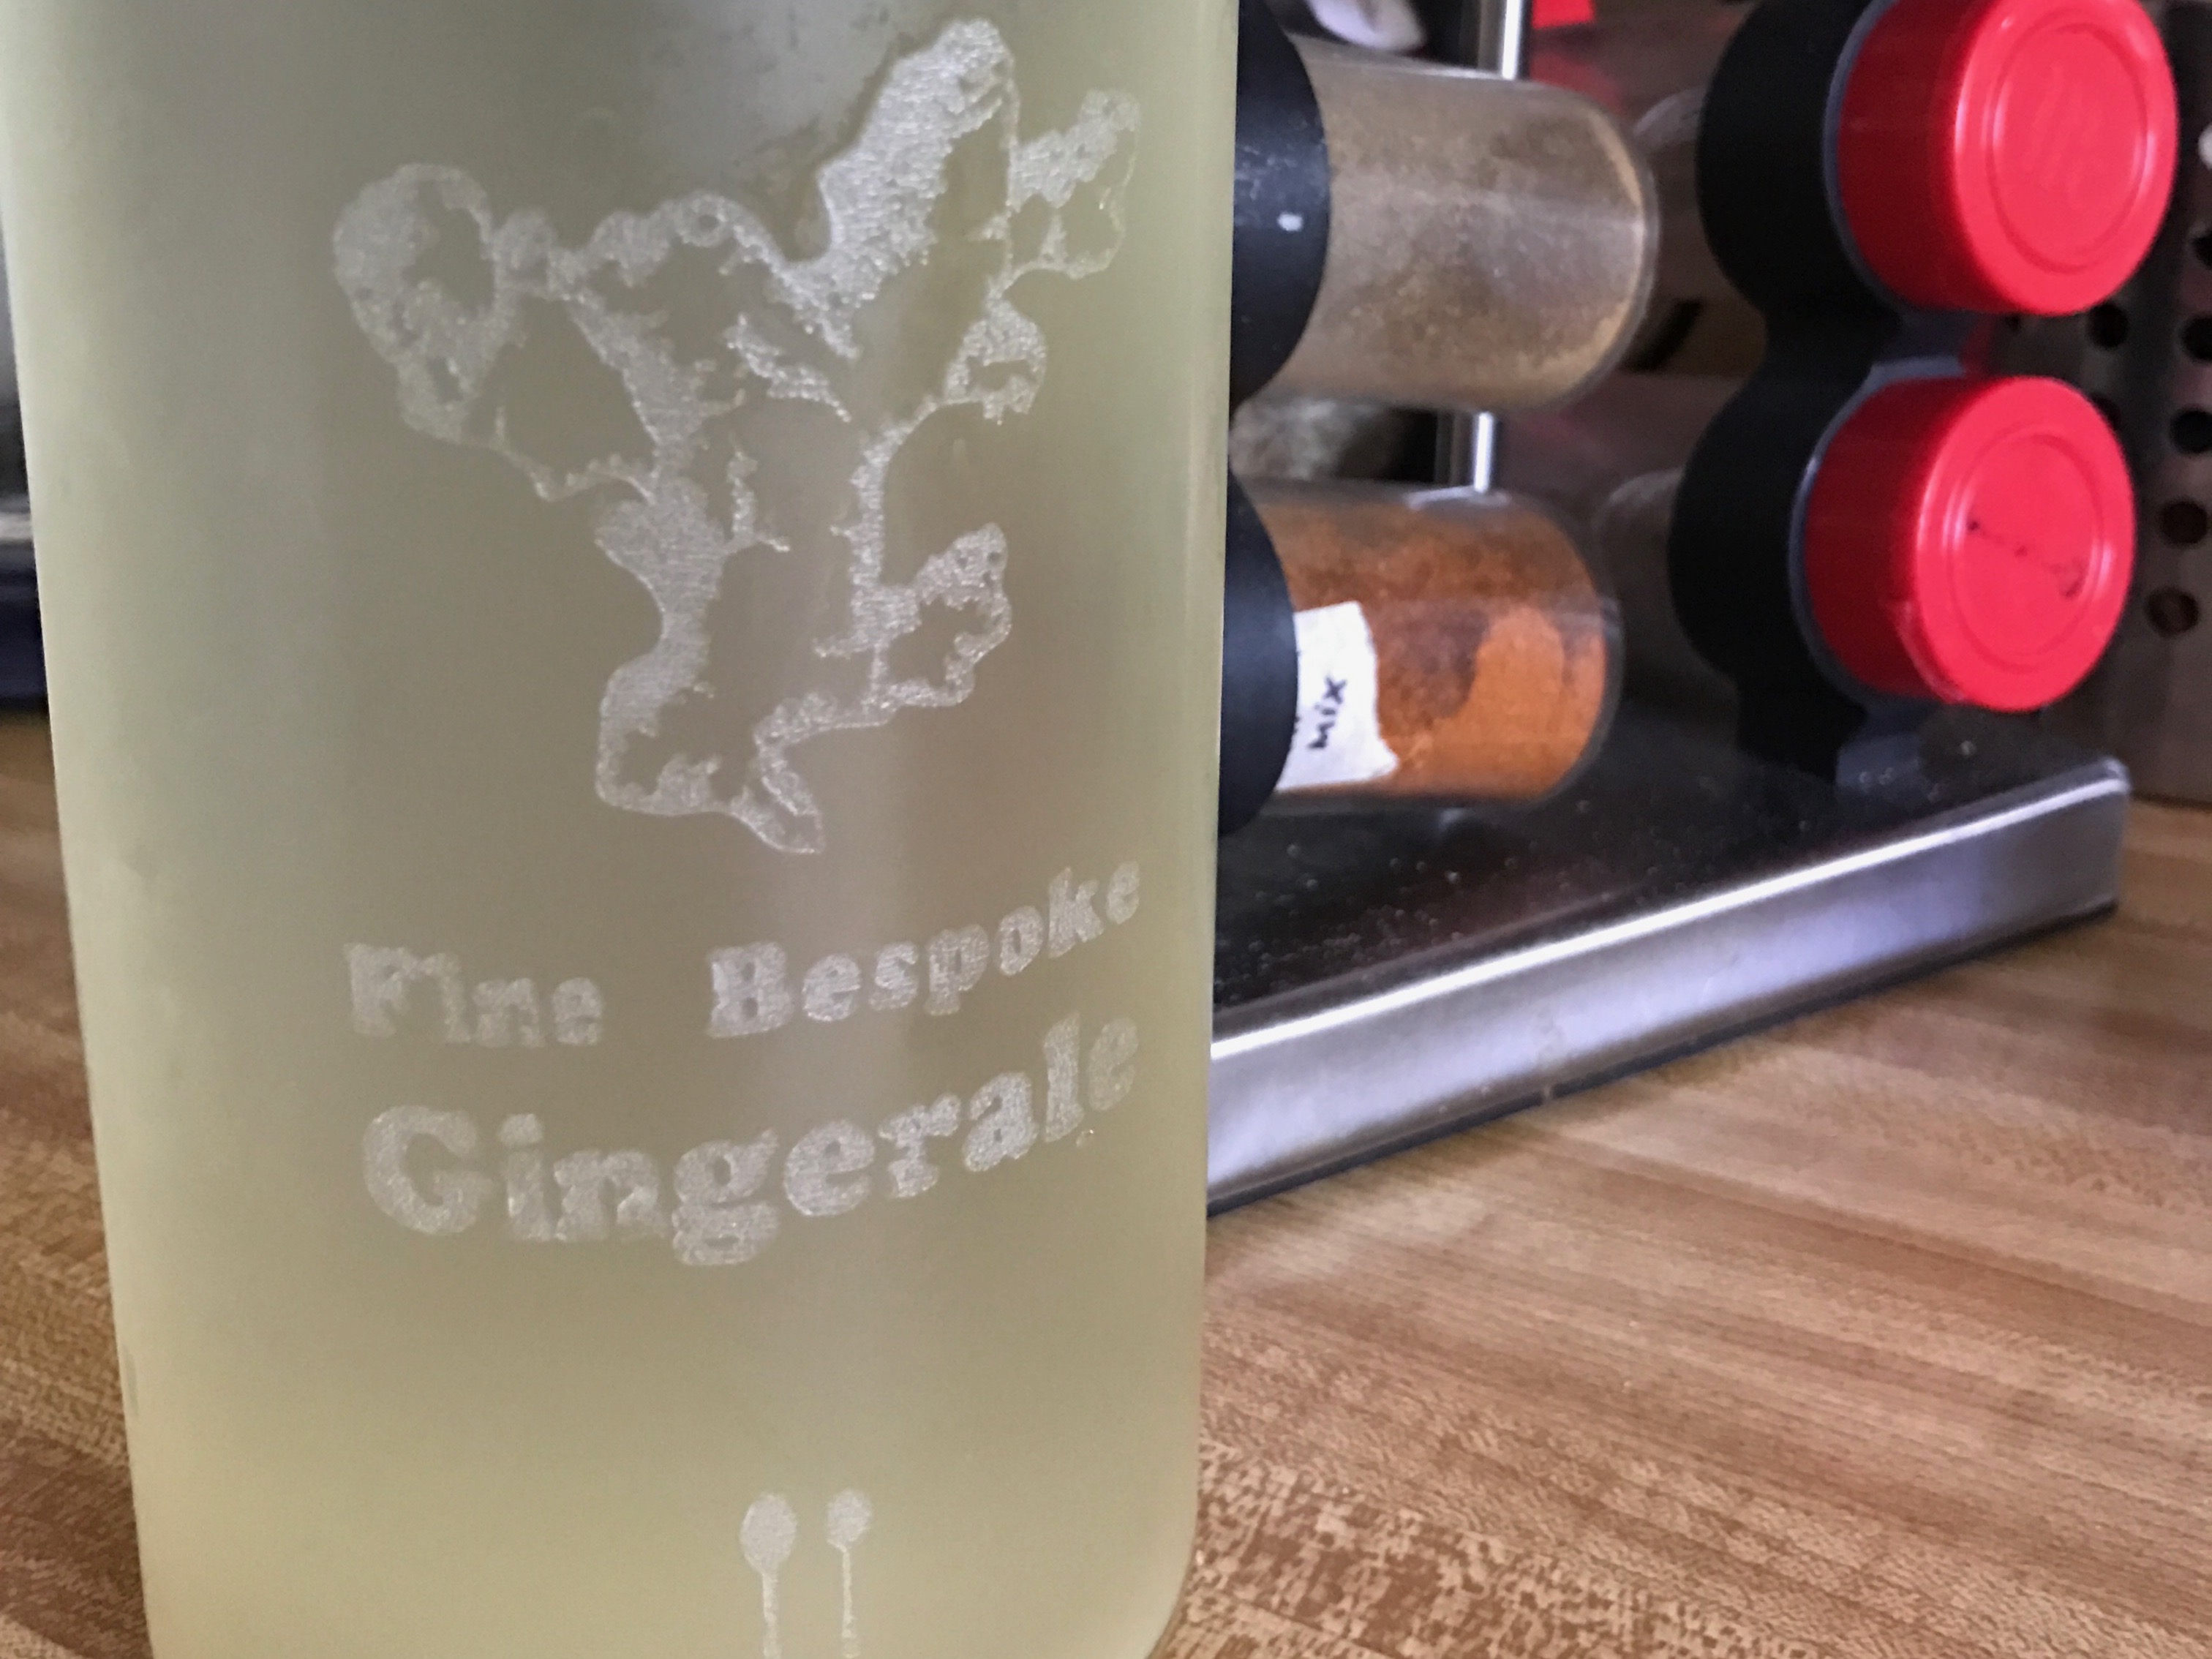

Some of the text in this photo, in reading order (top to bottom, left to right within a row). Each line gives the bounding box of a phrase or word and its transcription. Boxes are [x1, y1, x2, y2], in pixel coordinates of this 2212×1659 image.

[344, 860, 1140, 1049] Fine Bespoke
[363, 1012, 1140, 1265] Gingerale
